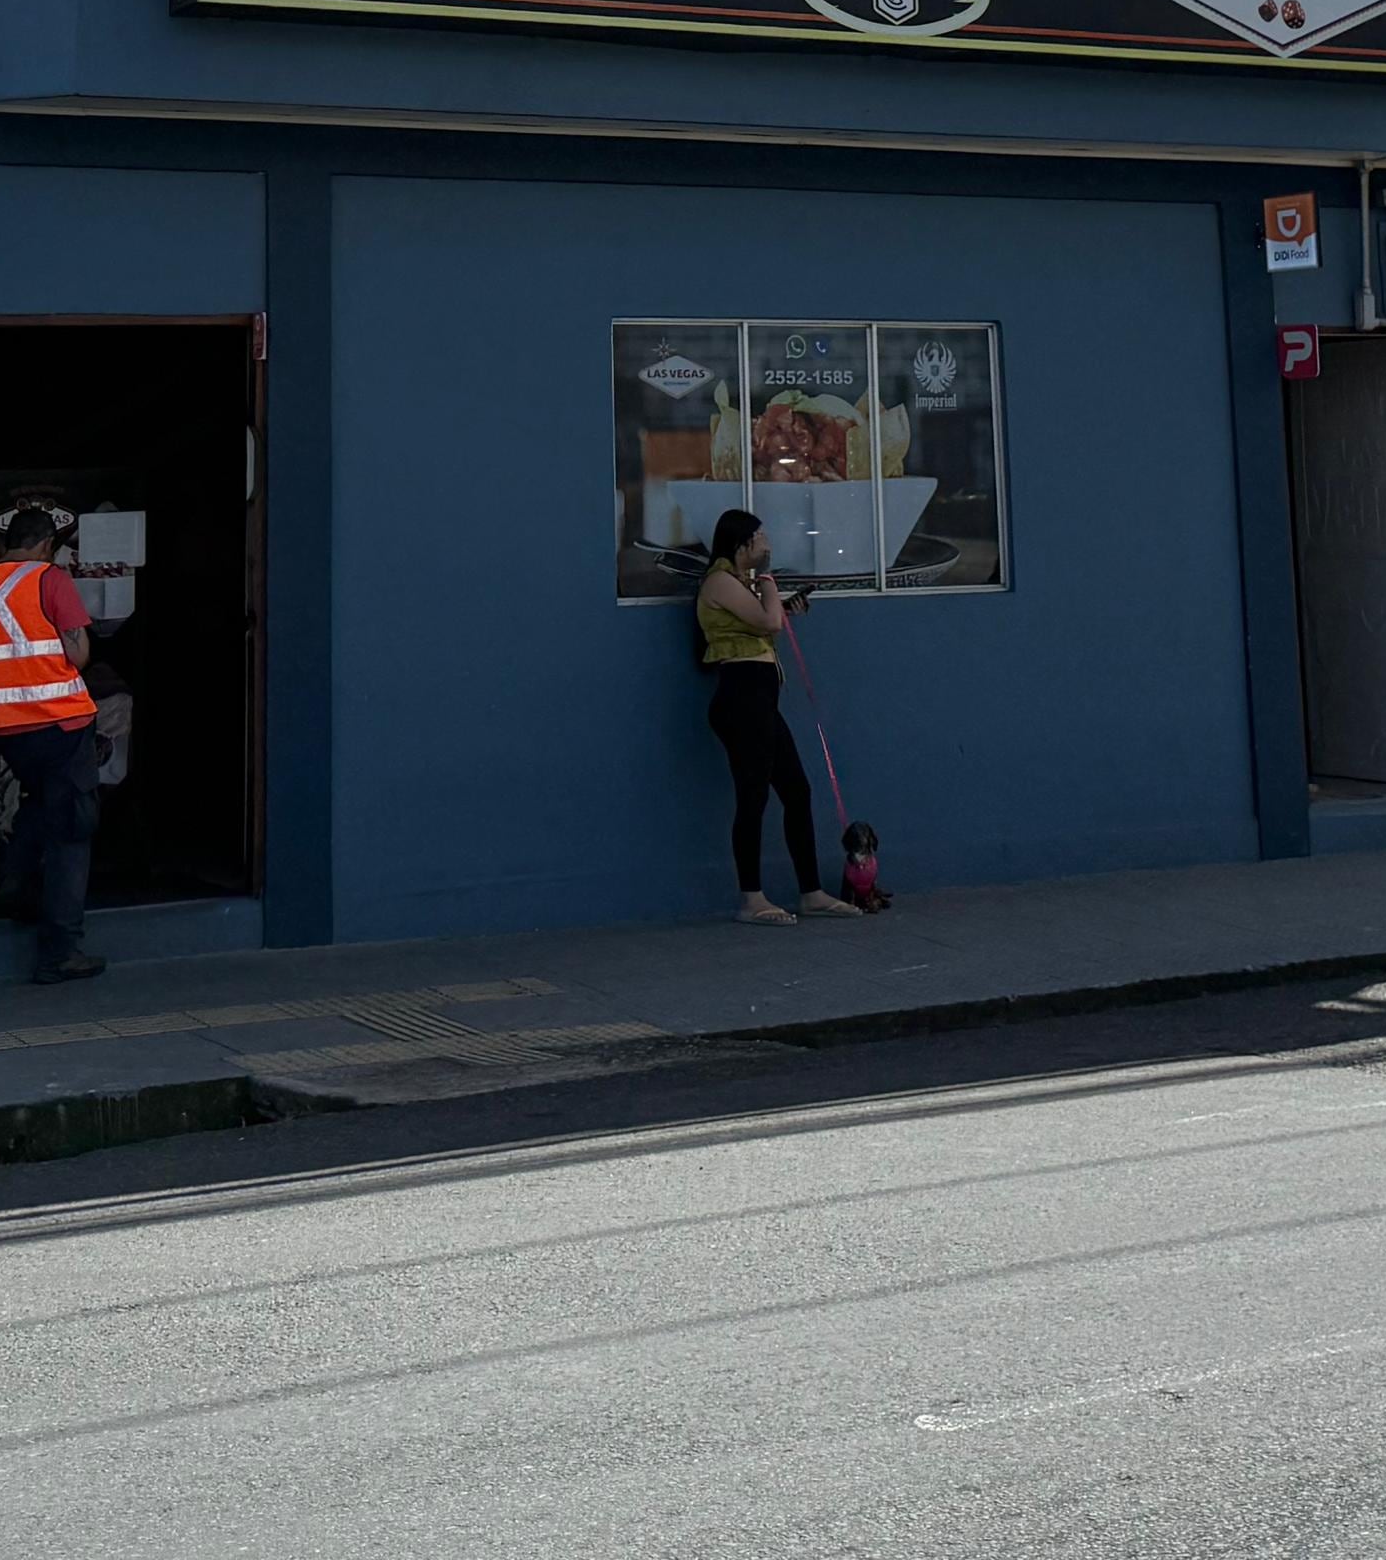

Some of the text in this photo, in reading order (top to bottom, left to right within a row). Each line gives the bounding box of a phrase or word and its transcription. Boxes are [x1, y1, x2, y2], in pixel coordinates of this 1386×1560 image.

[1291, 248, 1309, 259] Food
[647, 369, 705, 378] LAS VEGAS
[765, 370, 854, 385] 2552-1585
[915, 393, 957, 412] Imperial
